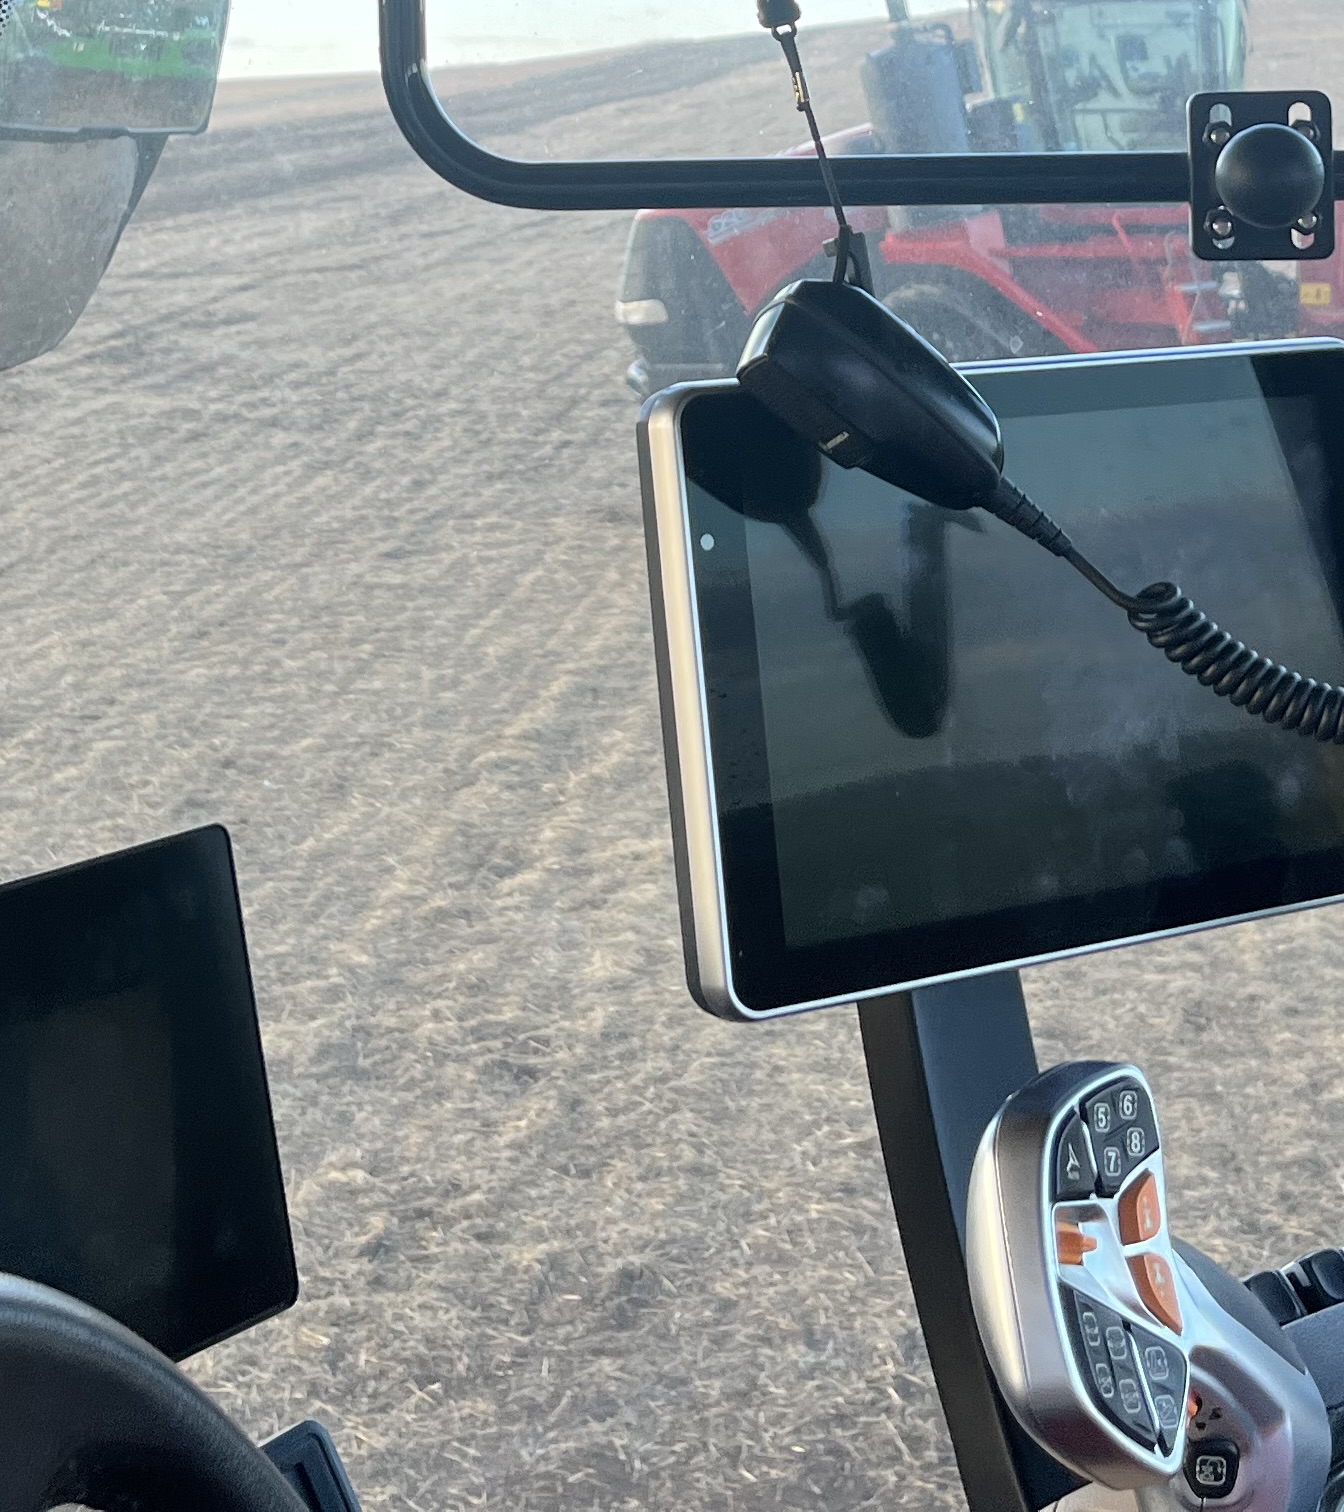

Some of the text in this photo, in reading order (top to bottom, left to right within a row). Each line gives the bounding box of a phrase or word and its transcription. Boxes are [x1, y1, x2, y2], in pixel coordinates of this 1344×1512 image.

[1123, 1094, 1134, 1115] 6
[1098, 1107, 1107, 1128] 5
[1131, 1131, 1141, 1152] 8
[1107, 1152, 1116, 1172] 7
